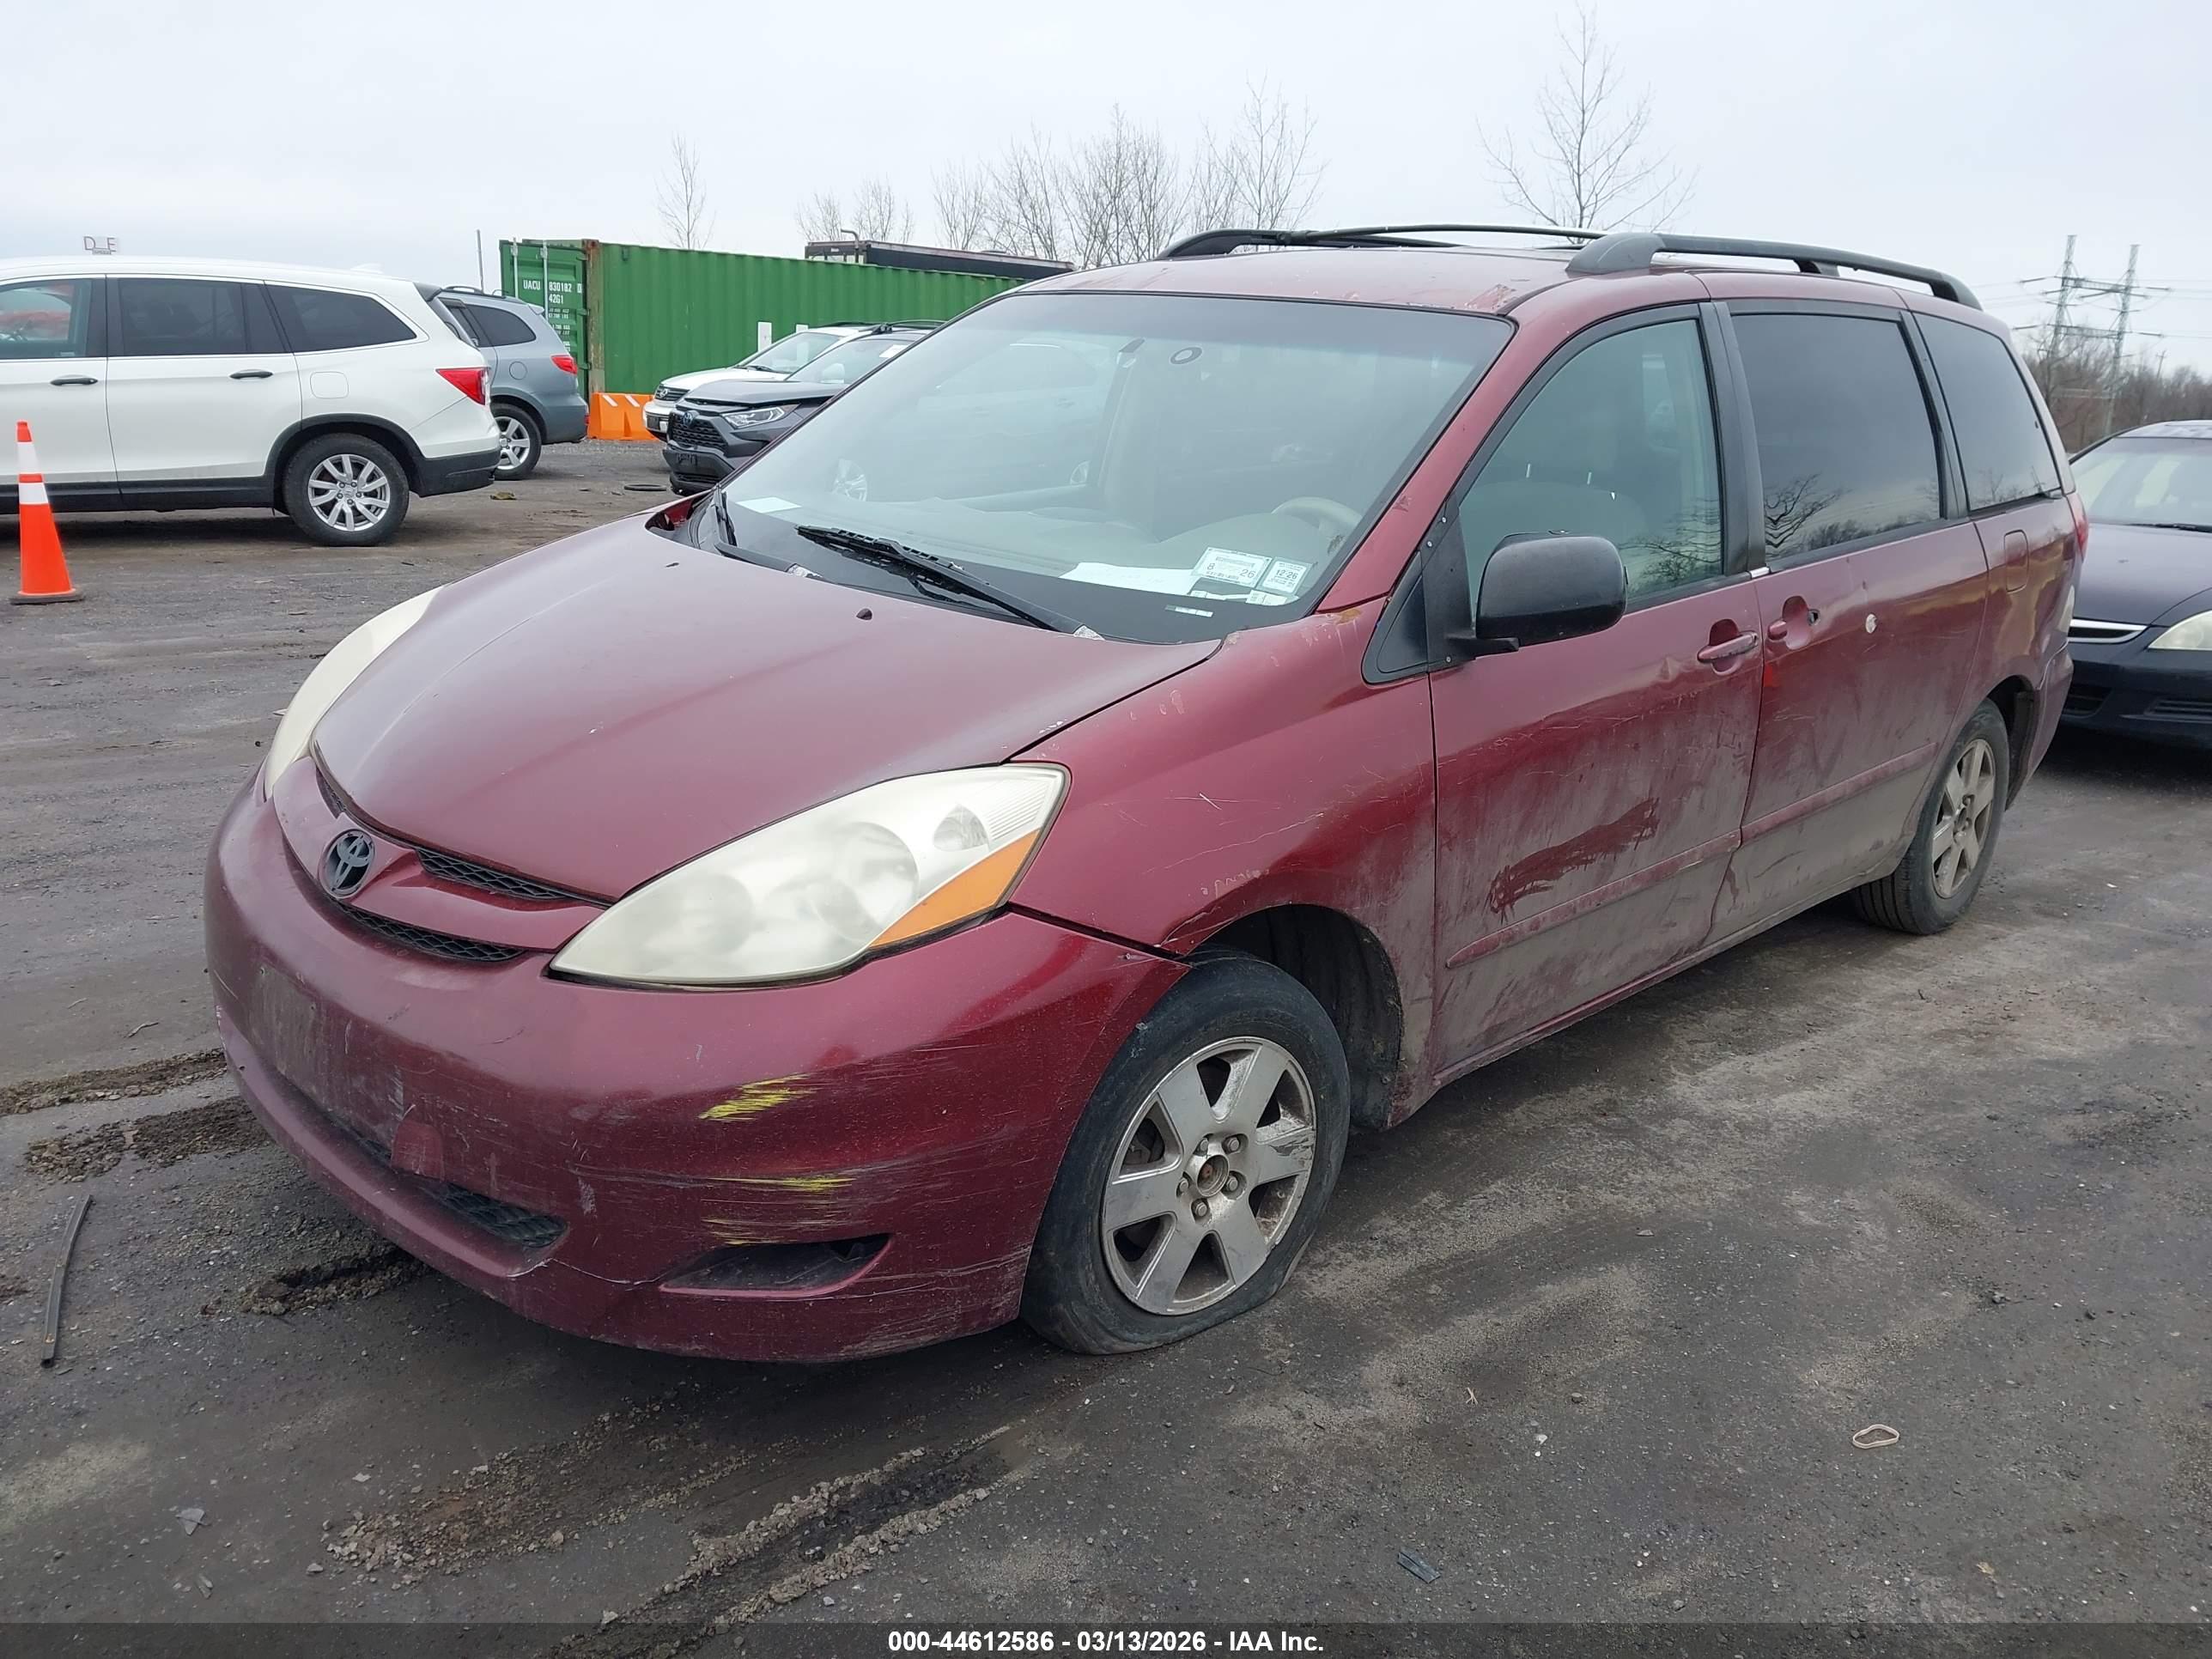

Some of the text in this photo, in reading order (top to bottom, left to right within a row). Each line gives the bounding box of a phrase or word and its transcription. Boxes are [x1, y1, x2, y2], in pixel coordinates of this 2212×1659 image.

[523, 280, 541, 290] UACU
[549, 282, 572, 292] 830182
[549, 295, 563, 304] 42G1
[1240, 568, 1255, 578] 26
